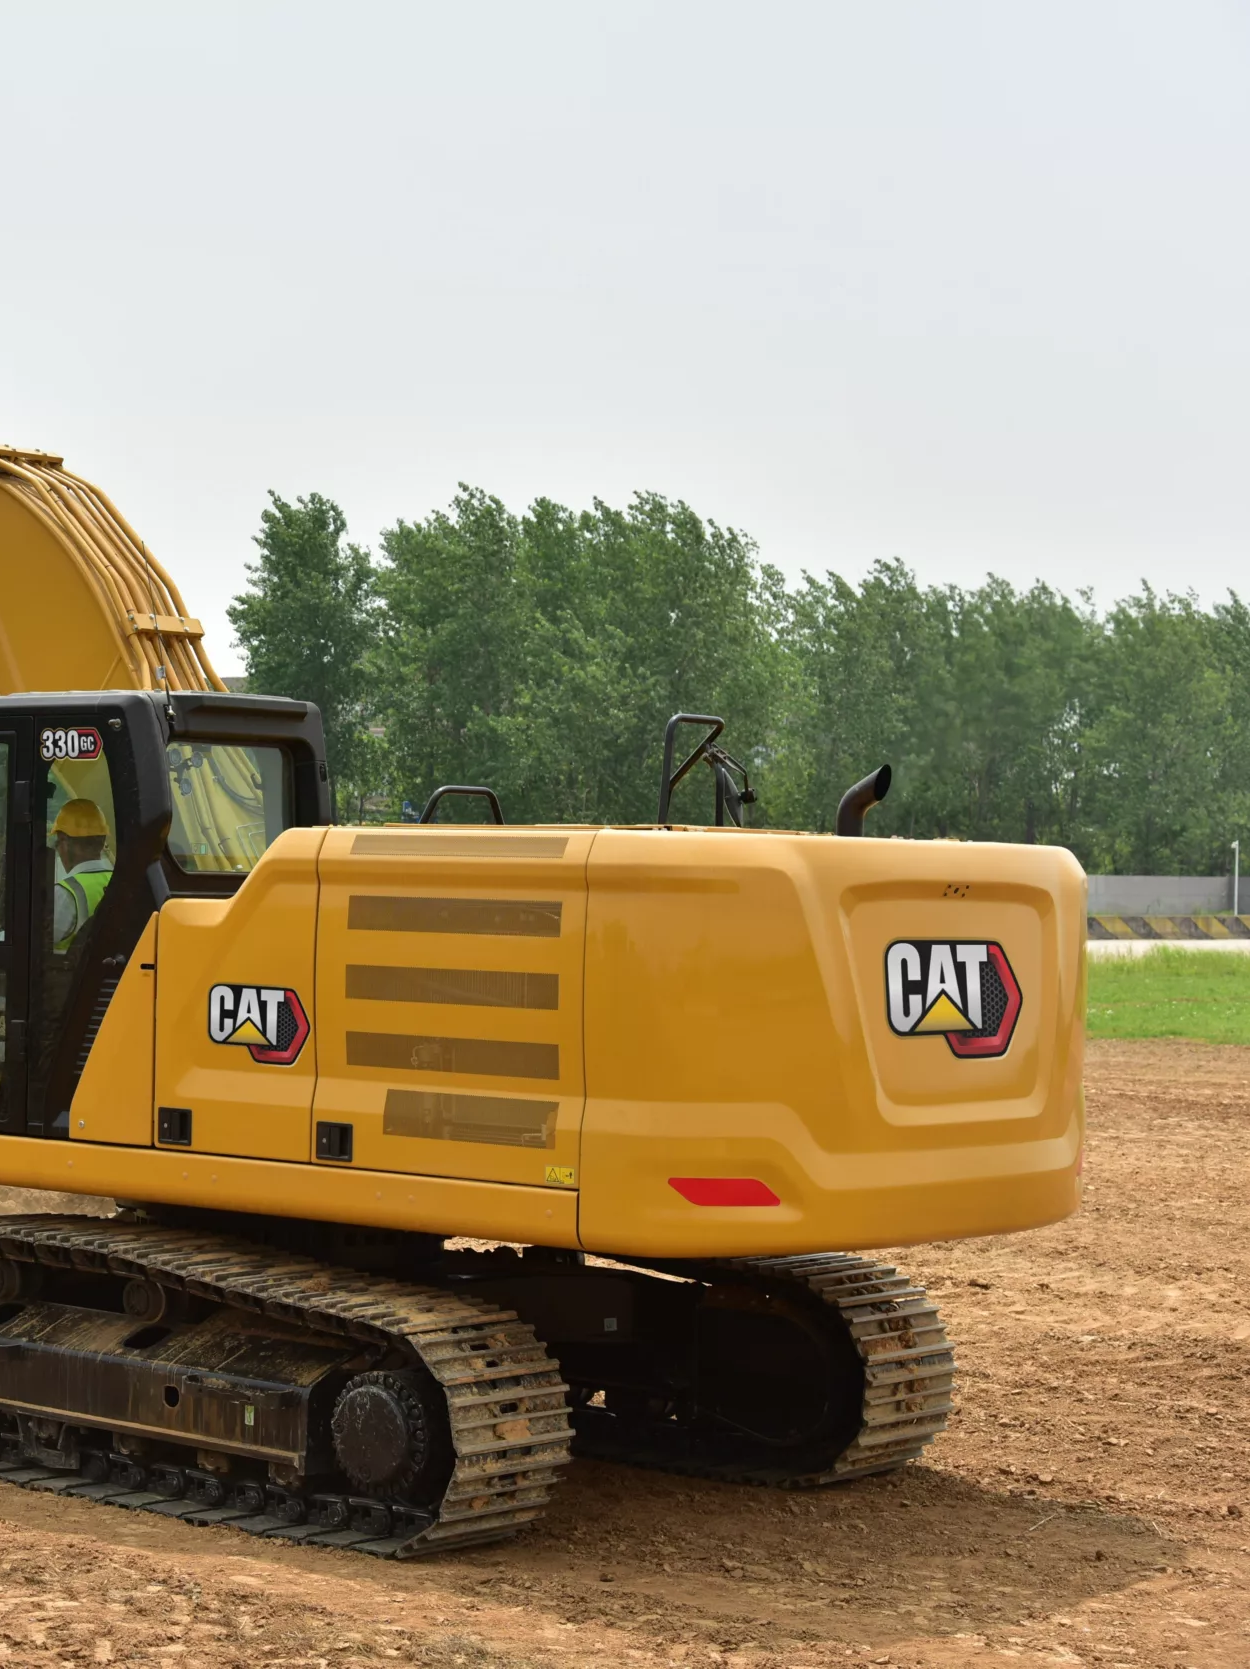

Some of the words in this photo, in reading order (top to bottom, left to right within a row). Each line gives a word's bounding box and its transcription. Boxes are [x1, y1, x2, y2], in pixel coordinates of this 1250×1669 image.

[42, 730, 79, 758] 330
[210, 985, 285, 1046] CAT
[887, 942, 988, 1032] CAT
